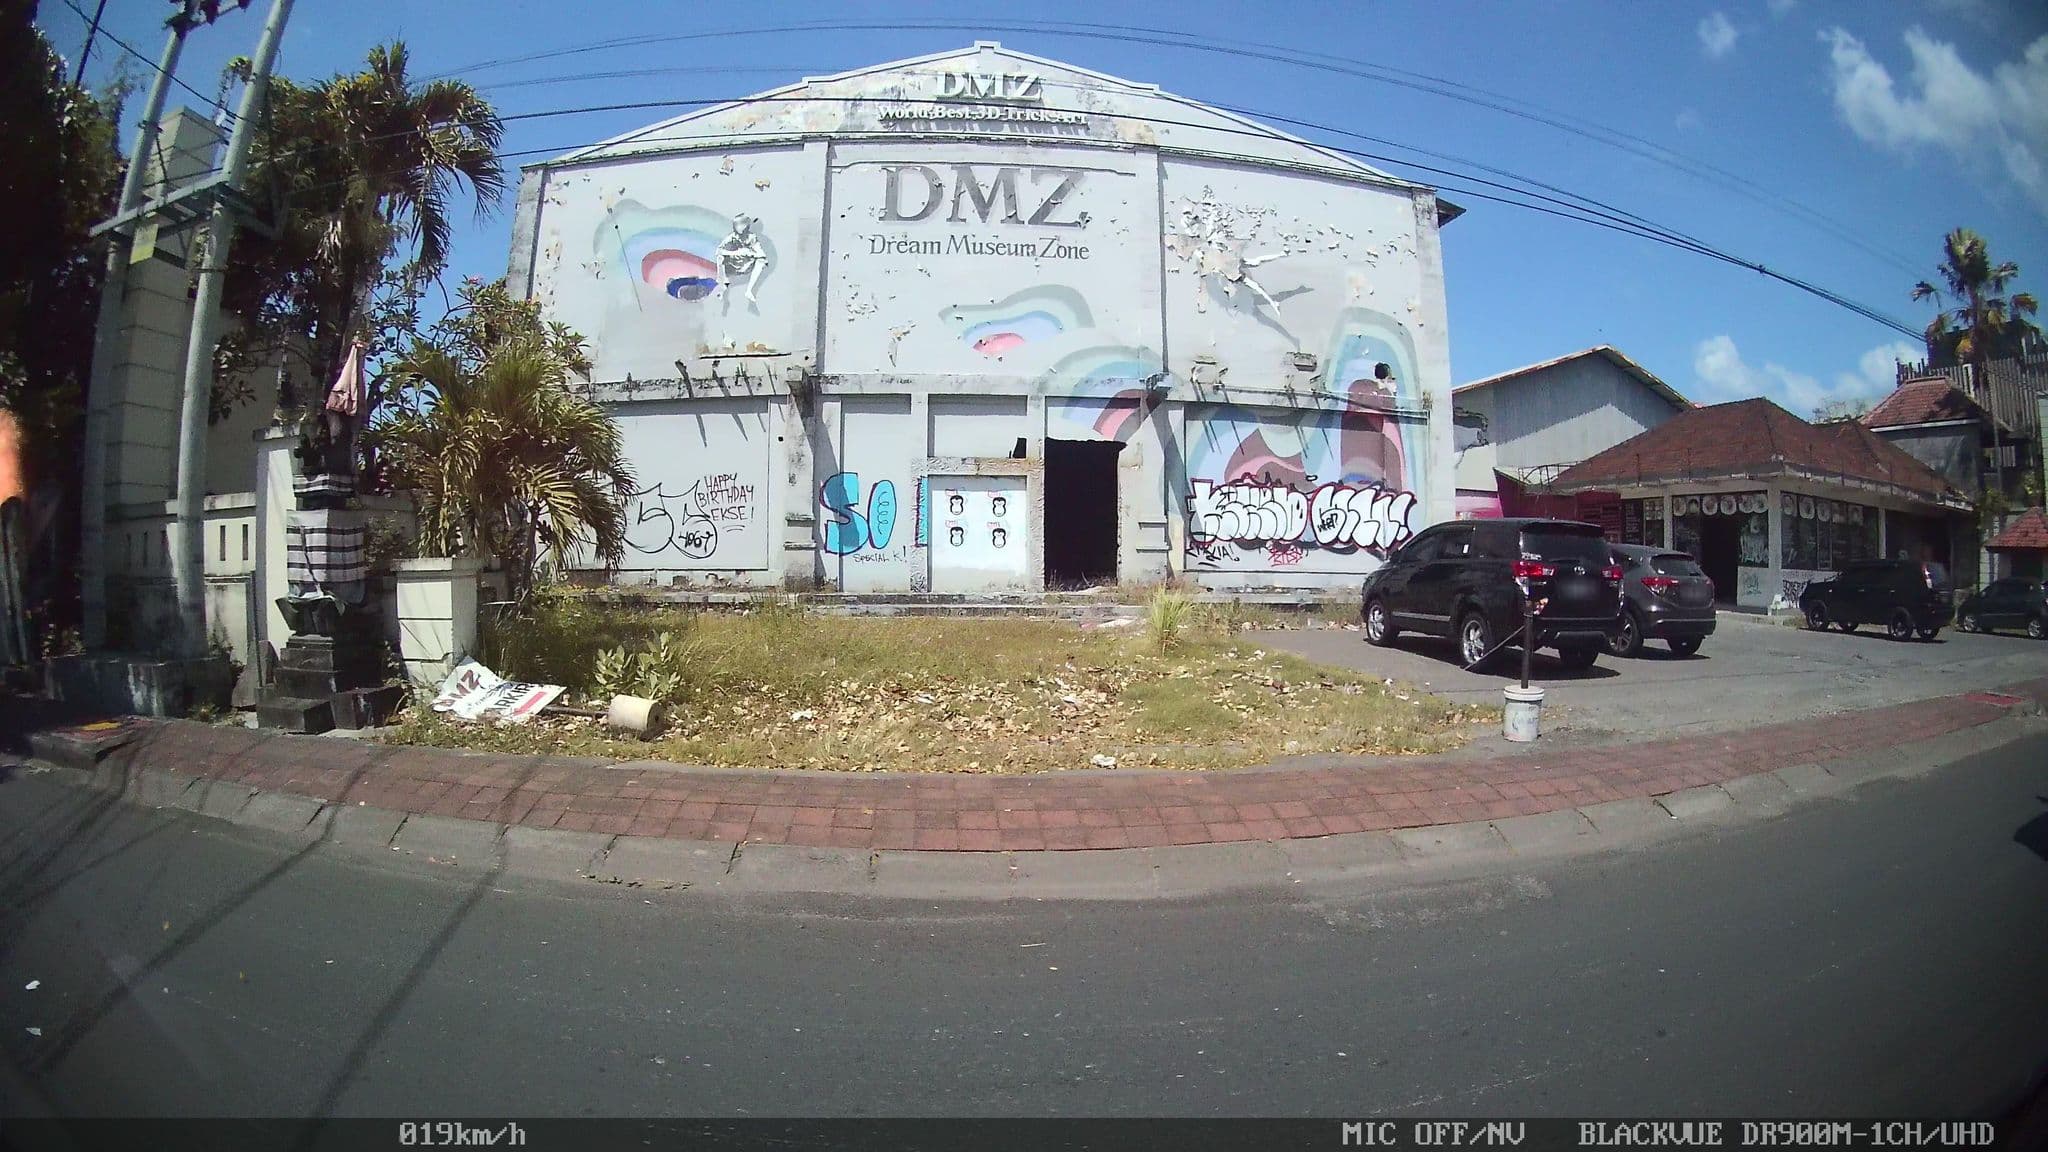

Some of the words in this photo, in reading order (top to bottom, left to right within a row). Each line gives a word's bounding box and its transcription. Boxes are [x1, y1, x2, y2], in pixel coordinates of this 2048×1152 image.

[936, 72, 1042, 100] DMZ
[936, 105, 971, 119] Best
[976, 105, 1000, 119] 3D
[1003, 107, 1049, 122] Trick
[878, 164, 1087, 227] DMZ
[870, 234, 941, 255] Dream
[946, 235, 1037, 257] Museum
[1039, 237, 1090, 260] Zone
[704, 473, 738, 493] HAPPY
[698, 485, 754, 508] BIRTHDAY
